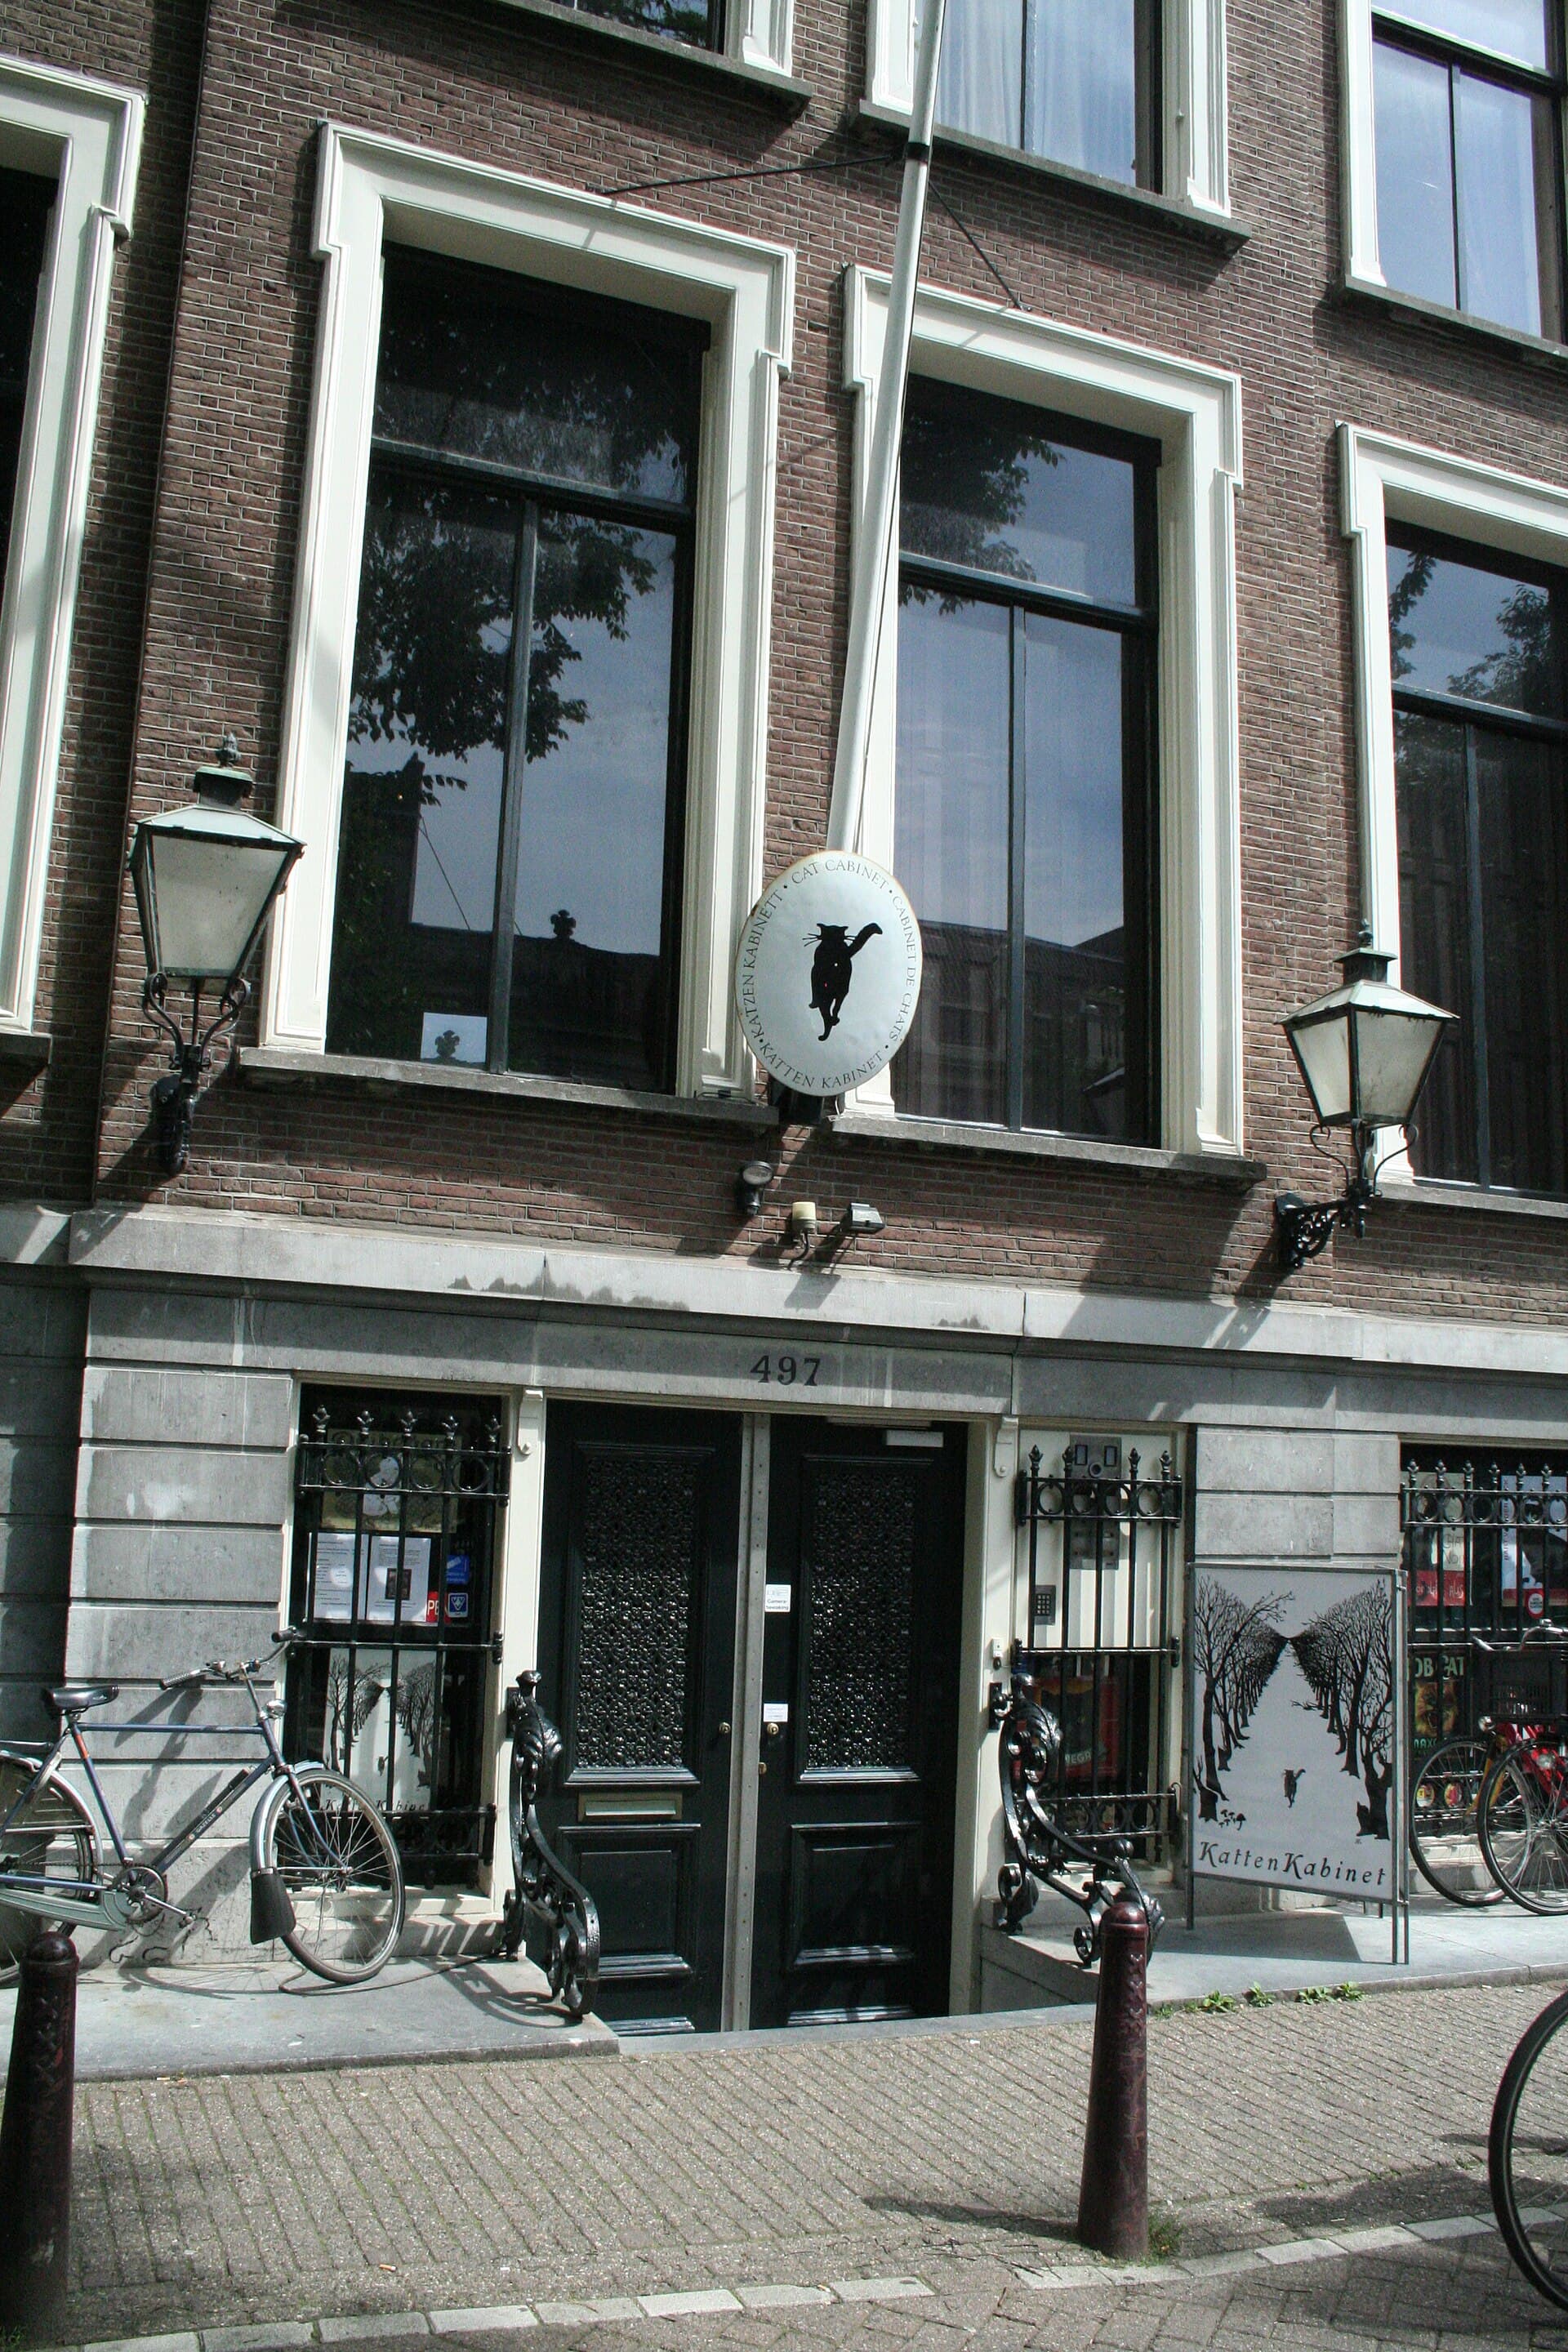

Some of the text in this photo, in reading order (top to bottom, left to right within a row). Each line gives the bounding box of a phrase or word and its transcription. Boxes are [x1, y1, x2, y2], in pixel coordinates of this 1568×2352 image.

[792, 859, 889, 889] CAT CABINET
[742, 889, 784, 1040] KATZEN KABINETT
[889, 895, 915, 1042] CABINET DE CHATS
[760, 1042, 884, 1089] KATTEN KABINET
[749, 1355, 821, 1386] 497
